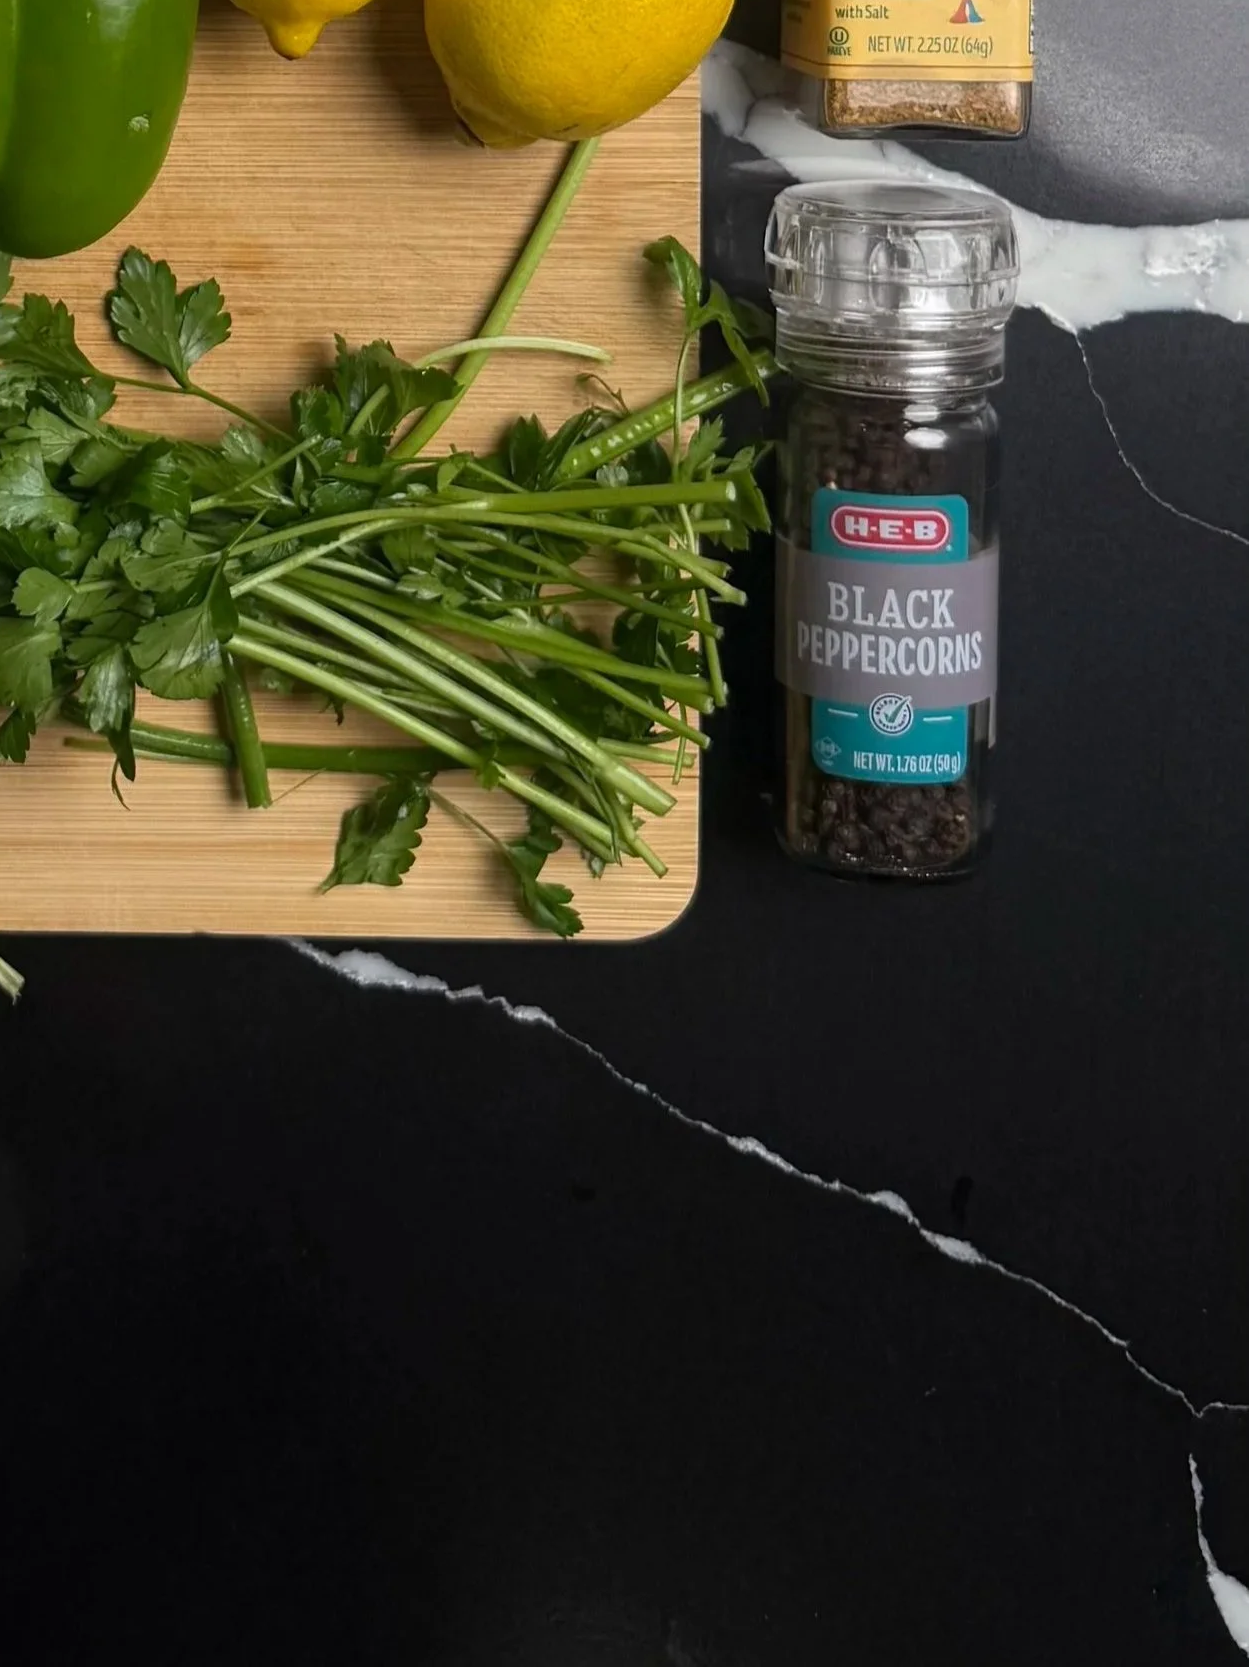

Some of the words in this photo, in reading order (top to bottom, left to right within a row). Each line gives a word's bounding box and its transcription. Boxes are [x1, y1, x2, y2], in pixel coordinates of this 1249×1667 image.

[835, 5, 862, 19] with
[865, 5, 889, 19] Salt
[868, 36, 891, 53] NET
[894, 36, 914, 53] WT.
[918, 36, 941, 53] 2.25
[944, 37, 958, 53] OZ
[961, 36, 993, 58] (64g)
[845, 514, 938, 541] H-E-B
[827, 581, 955, 630] BLACK
[797, 620, 982, 677] PEPPERCORNS
[853, 750, 873, 770] NET
[876, 753, 895, 772] WT.
[897, 755, 917, 773] 1.76
[919, 755, 932, 773] OZ
[933, 753, 950, 774] (50
[951, 751, 961, 774] g)
